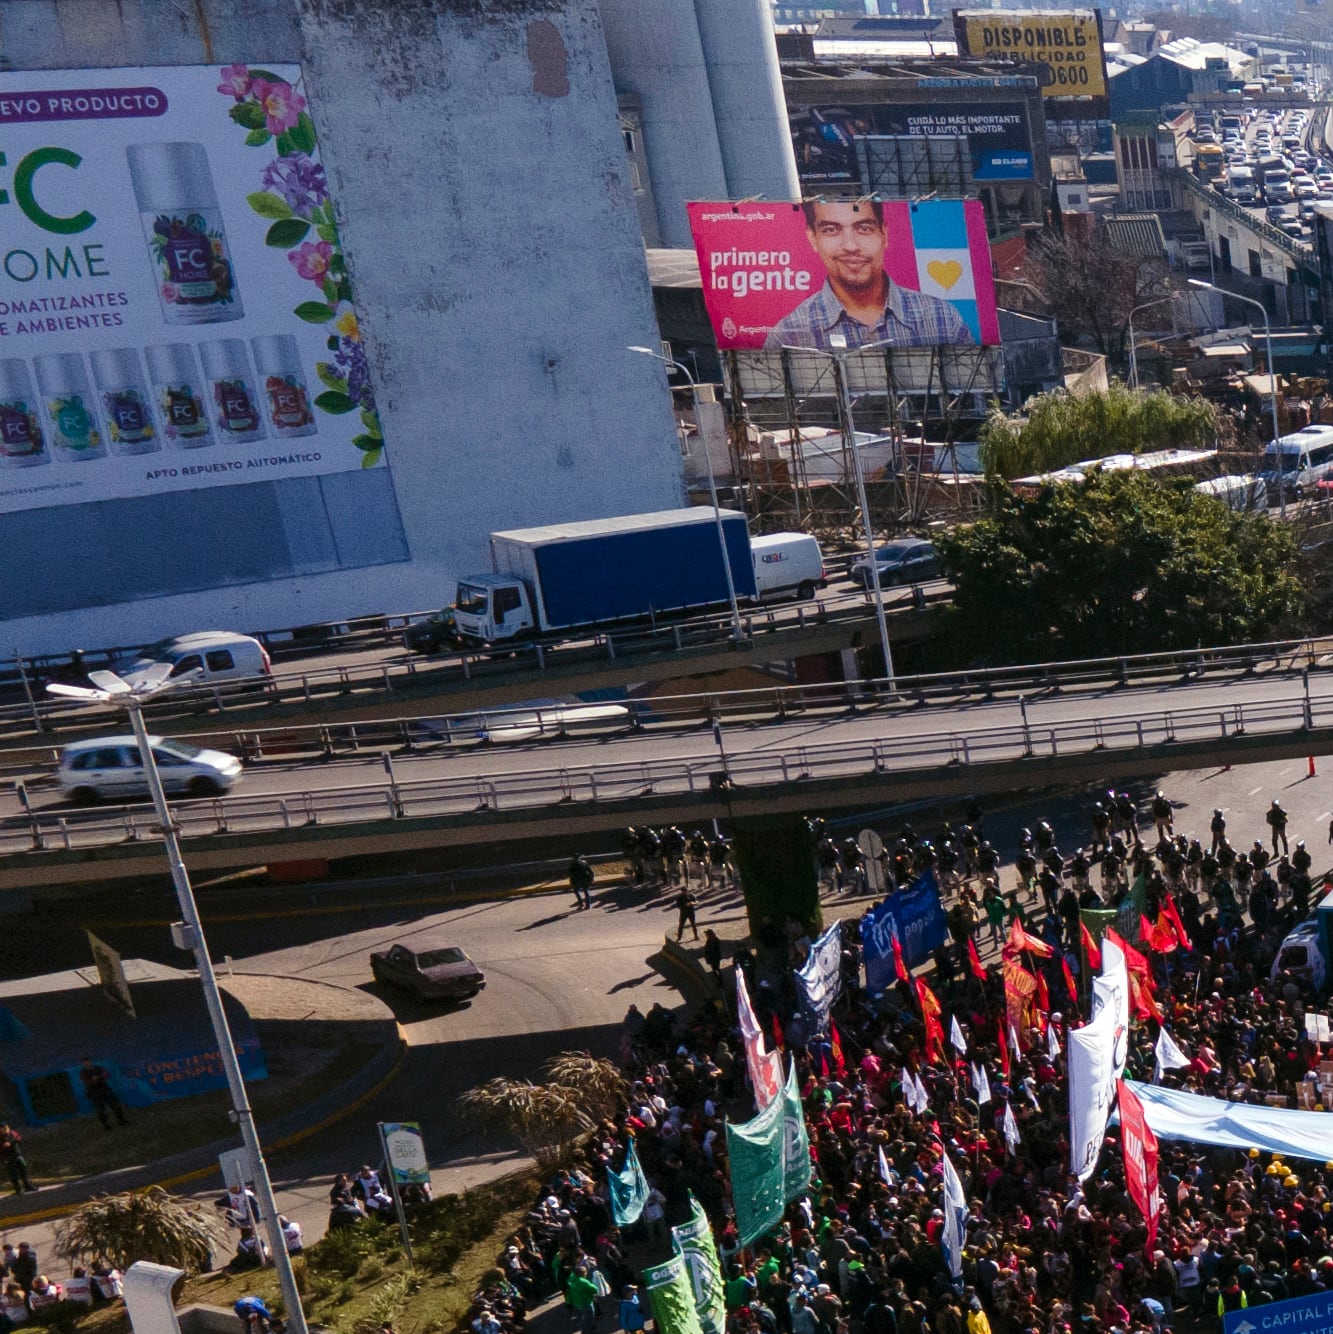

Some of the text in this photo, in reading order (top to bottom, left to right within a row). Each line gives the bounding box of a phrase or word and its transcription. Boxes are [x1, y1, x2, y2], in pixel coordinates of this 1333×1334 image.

[983, 27, 1086, 47] DISPONIBLE
[50, 94, 160, 113] PRODUCTO
[968, 115, 1021, 125] IMPORTANTE
[175, 249, 207, 269] FC
[710, 247, 790, 271] primero
[711, 267, 811, 298] la gente
[16, 312, 123, 334] AMBIENTES
[146, 451, 322, 481] APTO REPUESTO AUTOMÁTICO
[1262, 1309, 1323, 1329] CAPITAL
